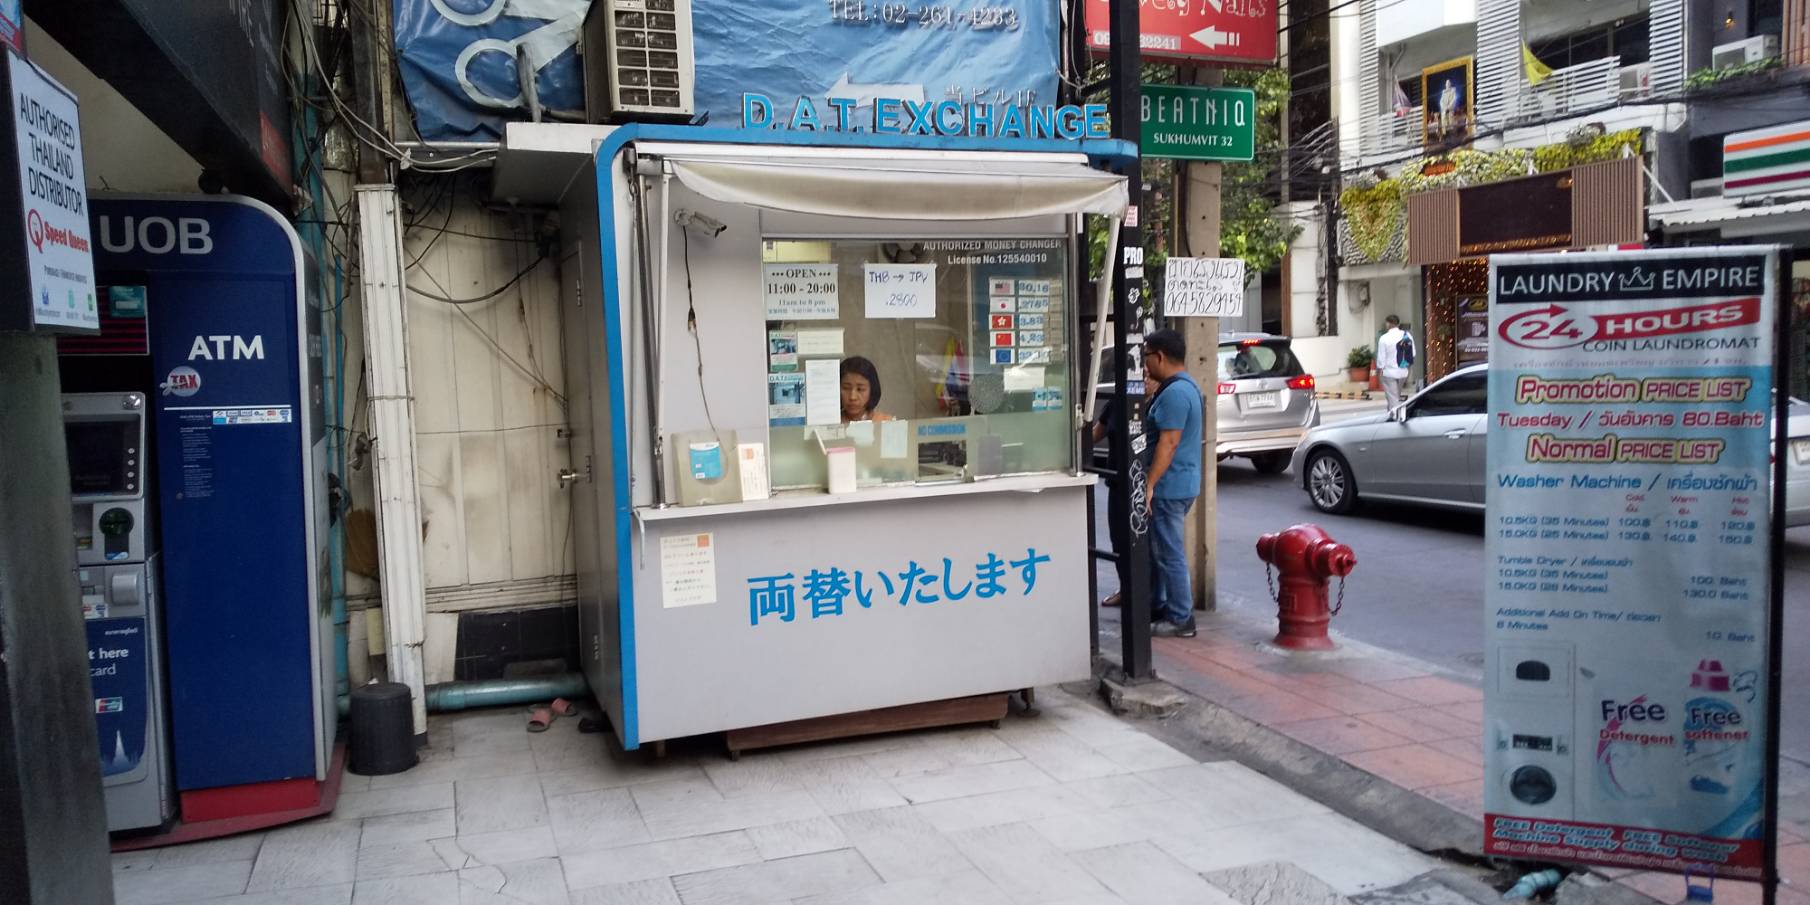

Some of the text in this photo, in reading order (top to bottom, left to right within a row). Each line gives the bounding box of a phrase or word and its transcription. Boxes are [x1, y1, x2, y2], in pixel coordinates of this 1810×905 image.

[20, 92, 76, 150] AUTHORISED
[873, 97, 1111, 139] EXCHANGE
[1153, 132, 1233, 147] SUKHUMVIT 32
[28, 131, 74, 180] THAILAND
[28, 166, 84, 216] DISTRIBUTOR
[44, 220, 89, 253] Speed Queen
[99, 215, 213, 255] UOB
[923, 239, 1061, 250] AUTHORIZED MONEY CHANGER
[948, 255, 981, 265] License
[1123, 247, 1144, 265] PRO
[786, 268, 817, 279] OPEN
[869, 272, 890, 283] THB
[1500, 266, 1760, 295] LAUNDRY EMPIRE
[768, 283, 796, 295] 11:00
[807, 283, 836, 294] 20:00
[1520, 305, 1744, 341] 24 HOURS
[188, 335, 265, 361] ATM
[1582, 337, 1762, 353] COIN LAUNDROMAT
[1519, 378, 1748, 400] Promotion PRICE LIST
[1498, 412, 1572, 430] Tuesday
[1682, 411, 1764, 427] 80.Baht
[1530, 437, 1721, 460] Normal PRICE LIST
[1498, 474, 1565, 489] Washer
[1570, 475, 1642, 489] Machine
[747, 548, 1051, 626] 両替いたします
[99, 648, 129, 660] here
[1601, 699, 1666, 722] Free
[1691, 707, 1742, 726] Free
[1599, 728, 1675, 746] Detergent
[1685, 728, 1750, 742] softener
[1533, 821, 1615, 838] Detergent
